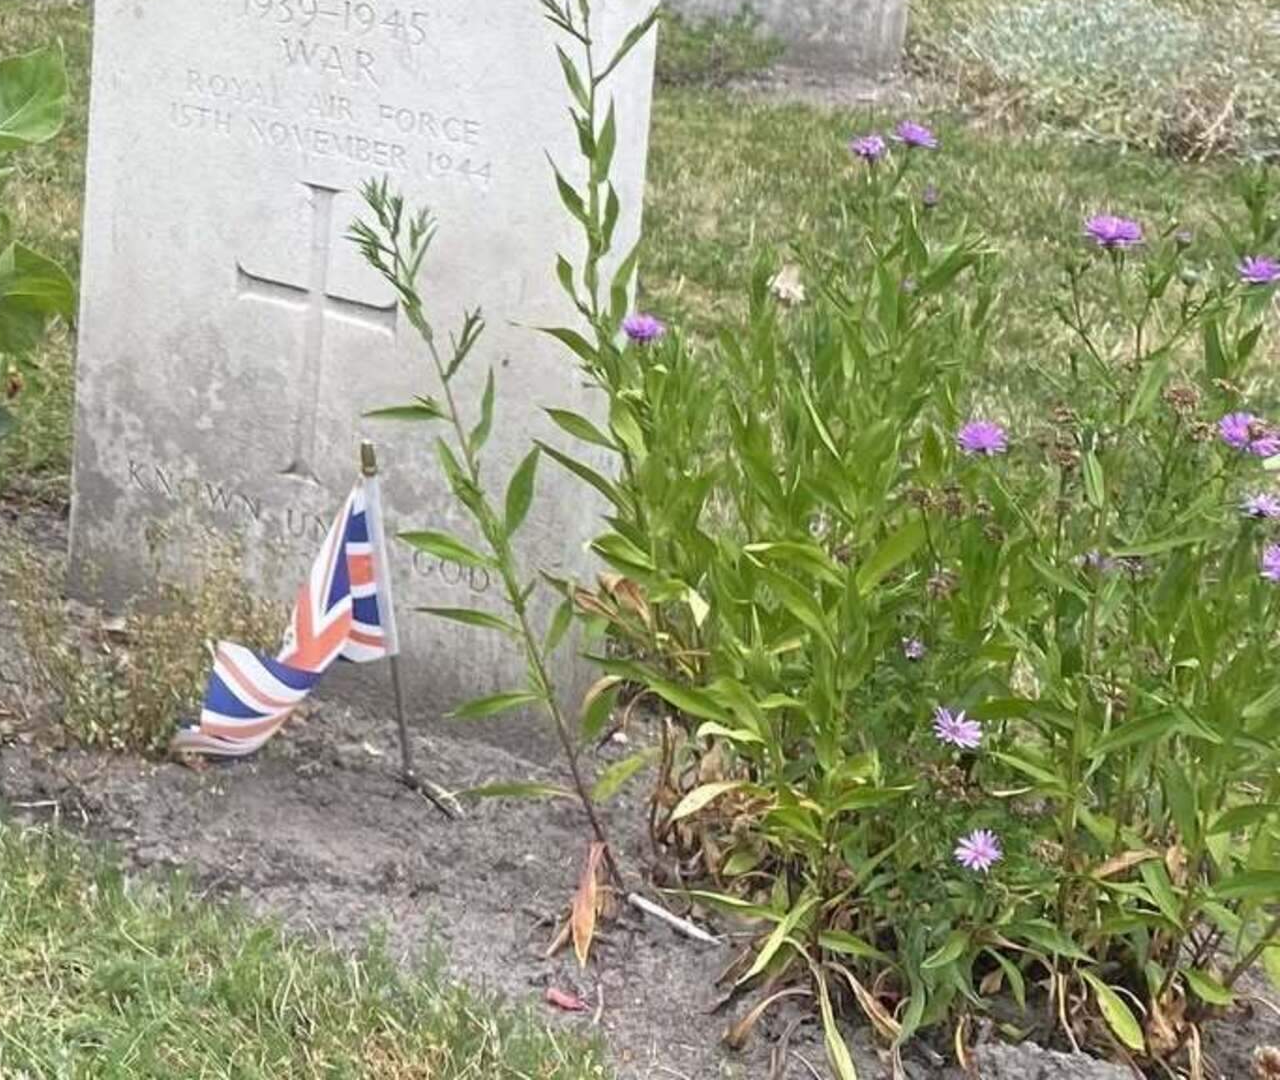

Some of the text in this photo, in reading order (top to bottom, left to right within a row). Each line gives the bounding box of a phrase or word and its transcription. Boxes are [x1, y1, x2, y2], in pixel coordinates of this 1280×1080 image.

[281, 36, 383, 89] WAR
[185, 68, 482, 147] ROYAL AIR FORCE
[169, 101, 494, 186] 15TH NOVEMBER 1944
[412, 546, 493, 594] GOD
